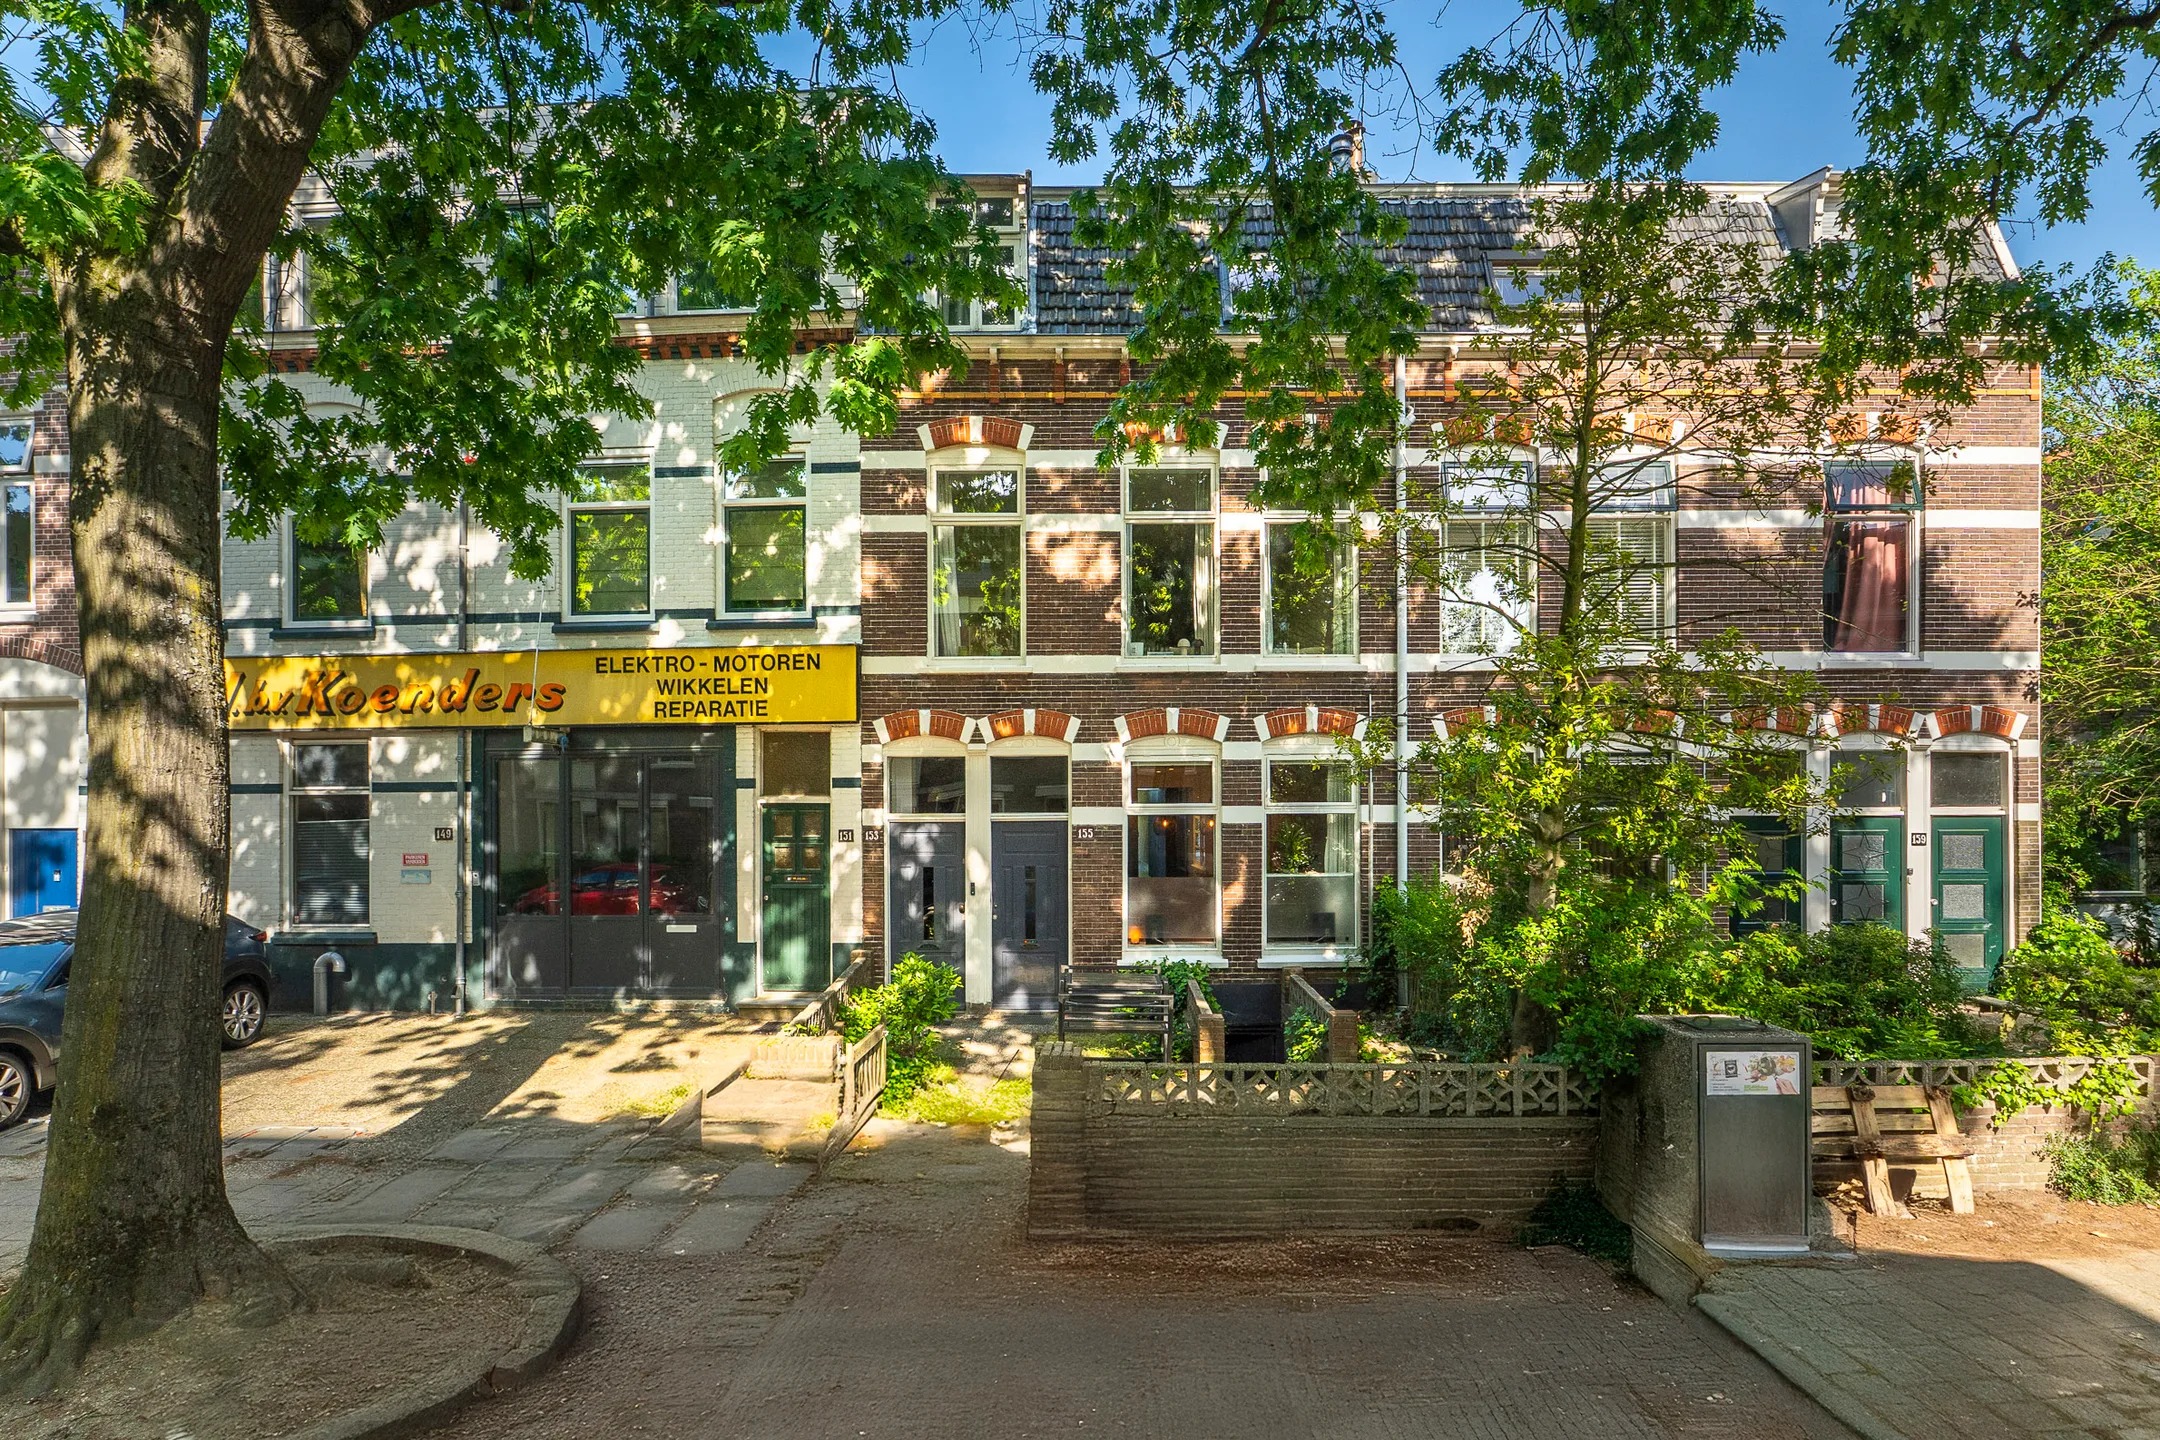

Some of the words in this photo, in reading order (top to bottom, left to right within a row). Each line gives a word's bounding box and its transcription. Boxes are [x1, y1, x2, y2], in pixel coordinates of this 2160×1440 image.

[595, 656, 695, 674] ELEKTRO
[713, 653, 821, 673] MOTOREN
[656, 677, 768, 696] WIKKELEN
[295, 669, 566, 717] Koenders
[654, 700, 768, 718] REPARATIE
[436, 829, 452, 839] 149
[839, 831, 852, 841] 151
[865, 830, 879, 841] 153
[1078, 828, 1094, 839] 155
[1912, 834, 1926, 844] 159
